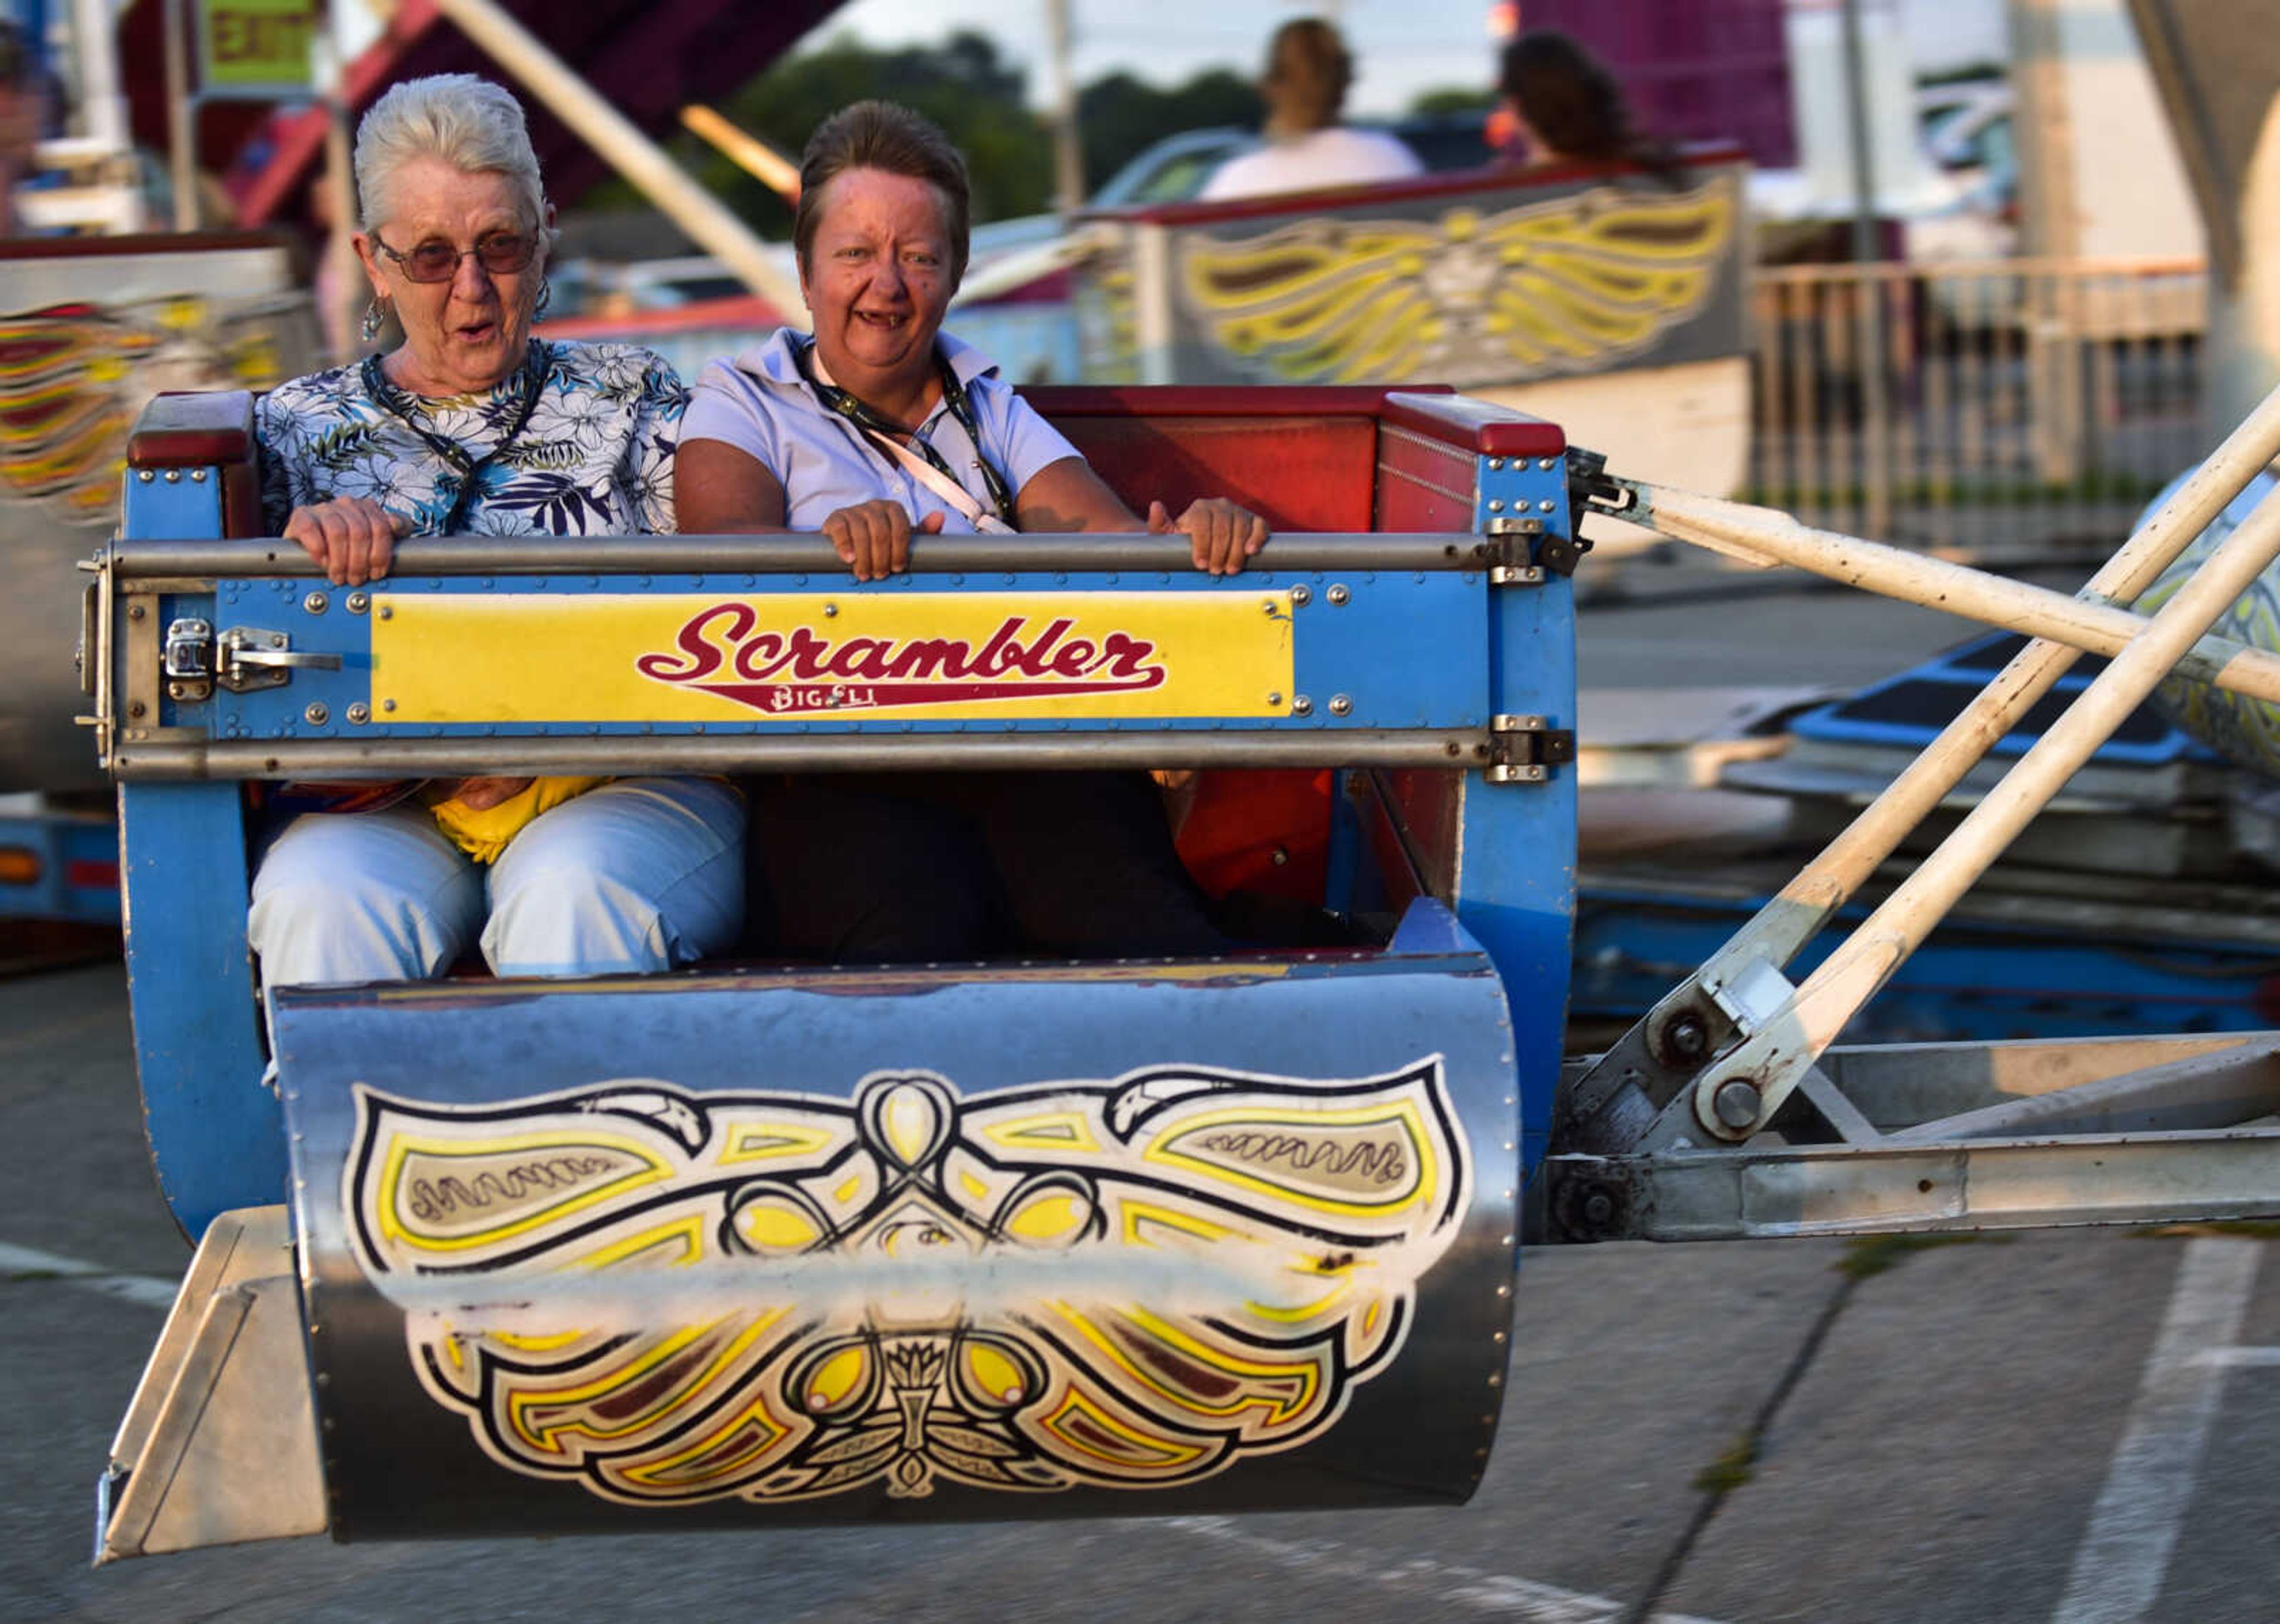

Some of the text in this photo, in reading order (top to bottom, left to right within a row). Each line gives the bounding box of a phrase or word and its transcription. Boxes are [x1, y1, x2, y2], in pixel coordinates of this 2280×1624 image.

[213, 11, 312, 62] EXIT
[637, 602, 1166, 690] Scrambler
[771, 684, 822, 710] BIG
